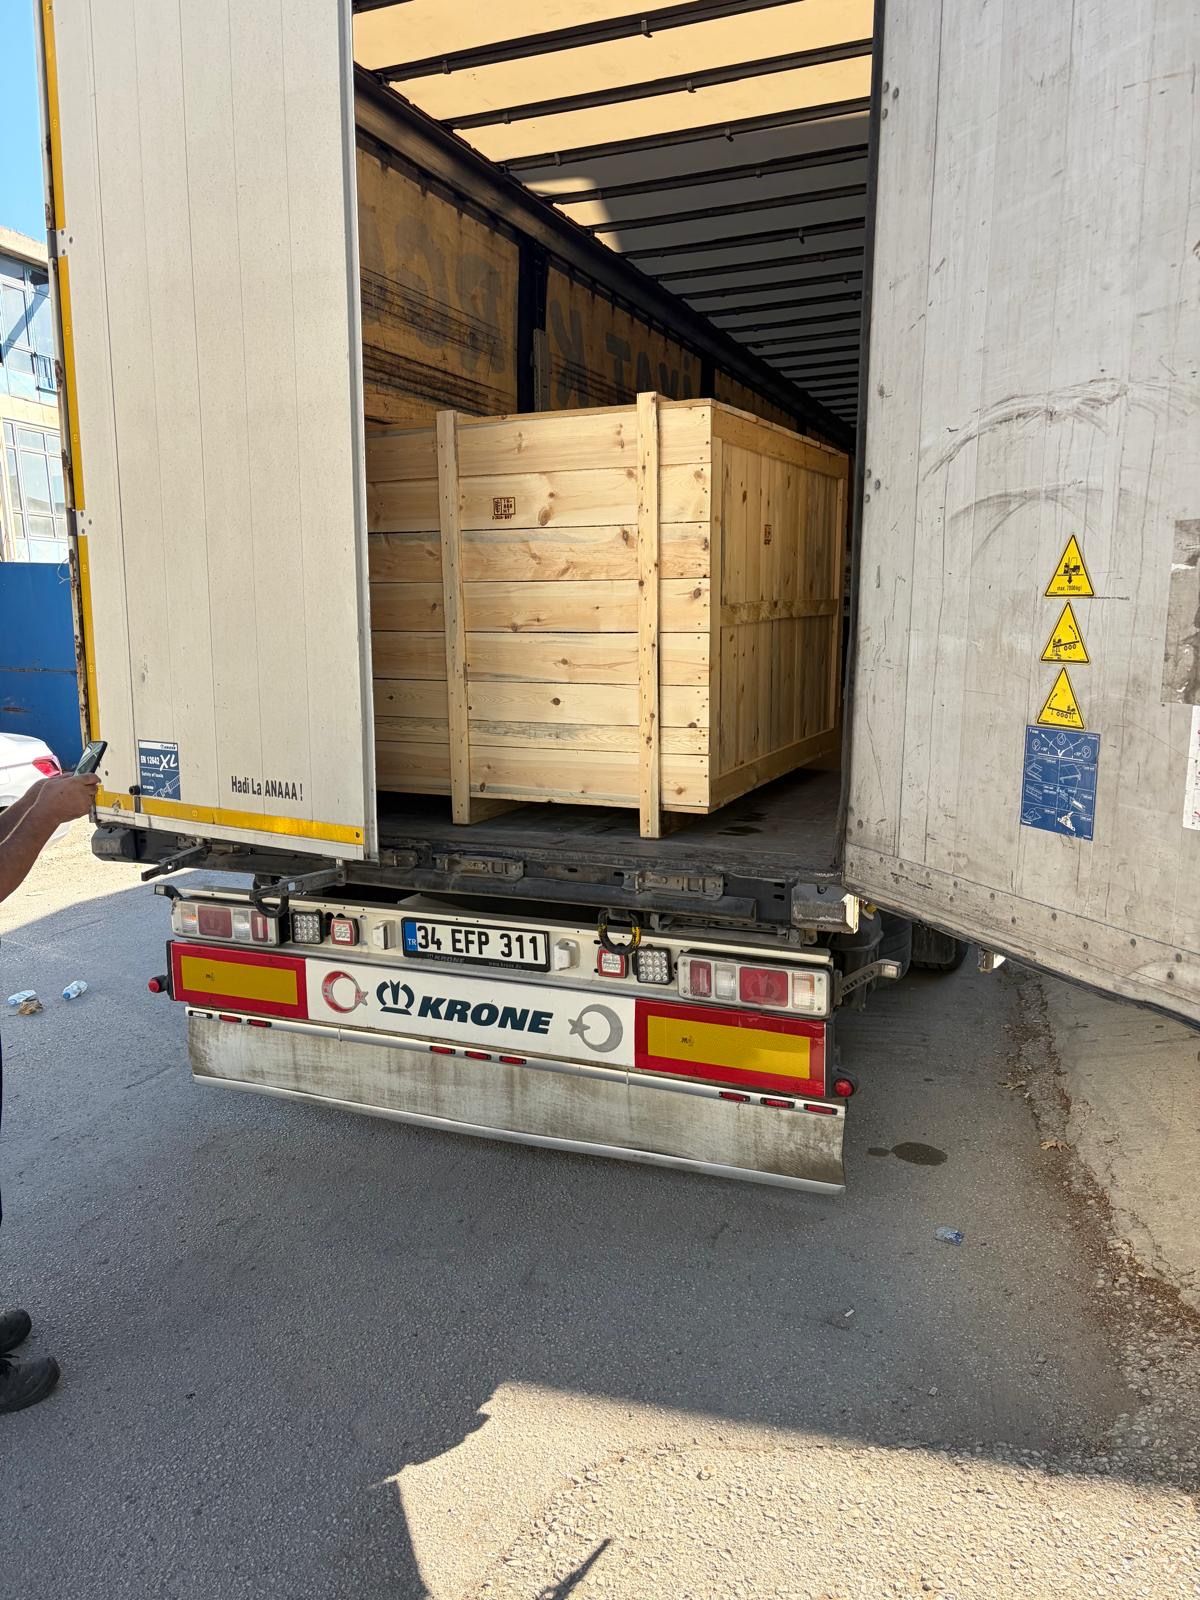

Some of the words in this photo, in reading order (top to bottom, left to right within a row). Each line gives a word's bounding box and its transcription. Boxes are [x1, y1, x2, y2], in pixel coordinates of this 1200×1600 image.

[159, 754, 178, 772] XL
[231, 775, 250, 794] Hadi
[251, 778, 262, 796] La
[264, 779, 298, 801] ANAAA
[407, 938, 417, 946] TR
[417, 925, 443, 951] 34
[451, 928, 490, 955] EFP
[499, 933, 539, 961] 311
[418, 995, 555, 1035] KRONE
